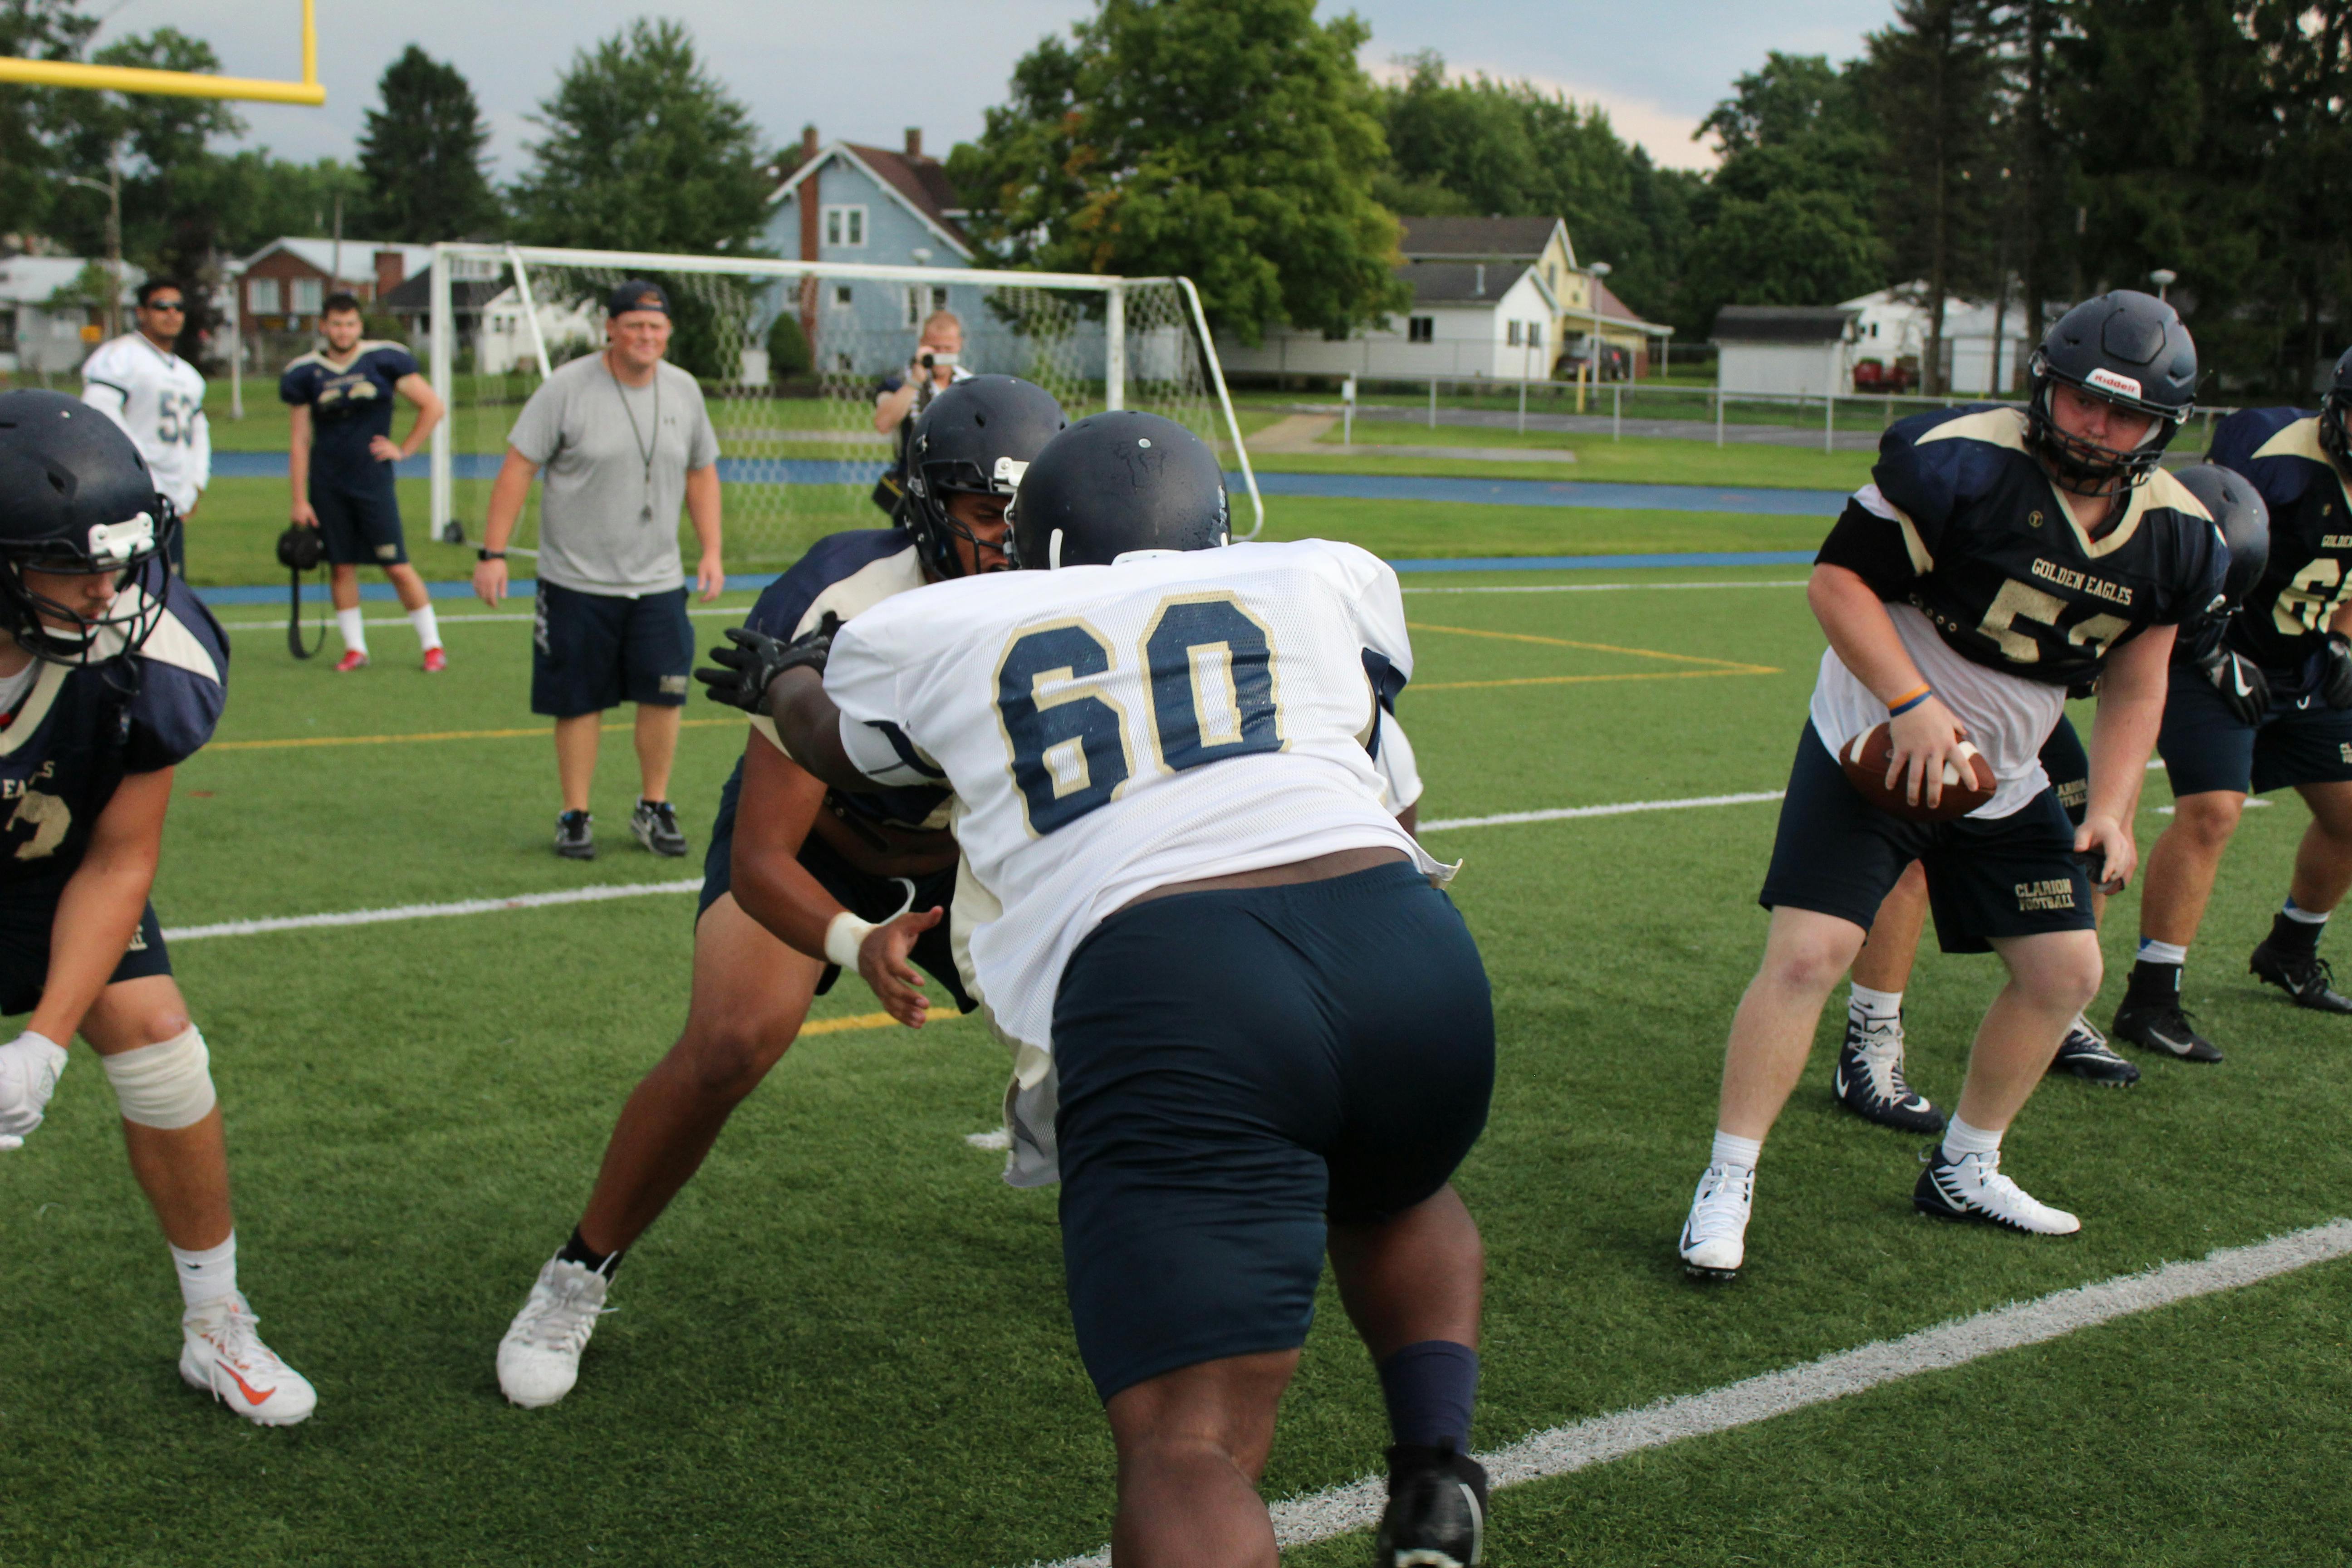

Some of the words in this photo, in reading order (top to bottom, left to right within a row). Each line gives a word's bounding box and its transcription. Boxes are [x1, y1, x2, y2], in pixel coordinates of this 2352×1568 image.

[2031, 558, 2086, 590] GOLDEN
[2085, 576, 2133, 606] EAGLES
[990, 589, 1293, 840] 60
[2014, 878, 2073, 898] CLARION
[2019, 894, 2075, 911] FOOTBALL
